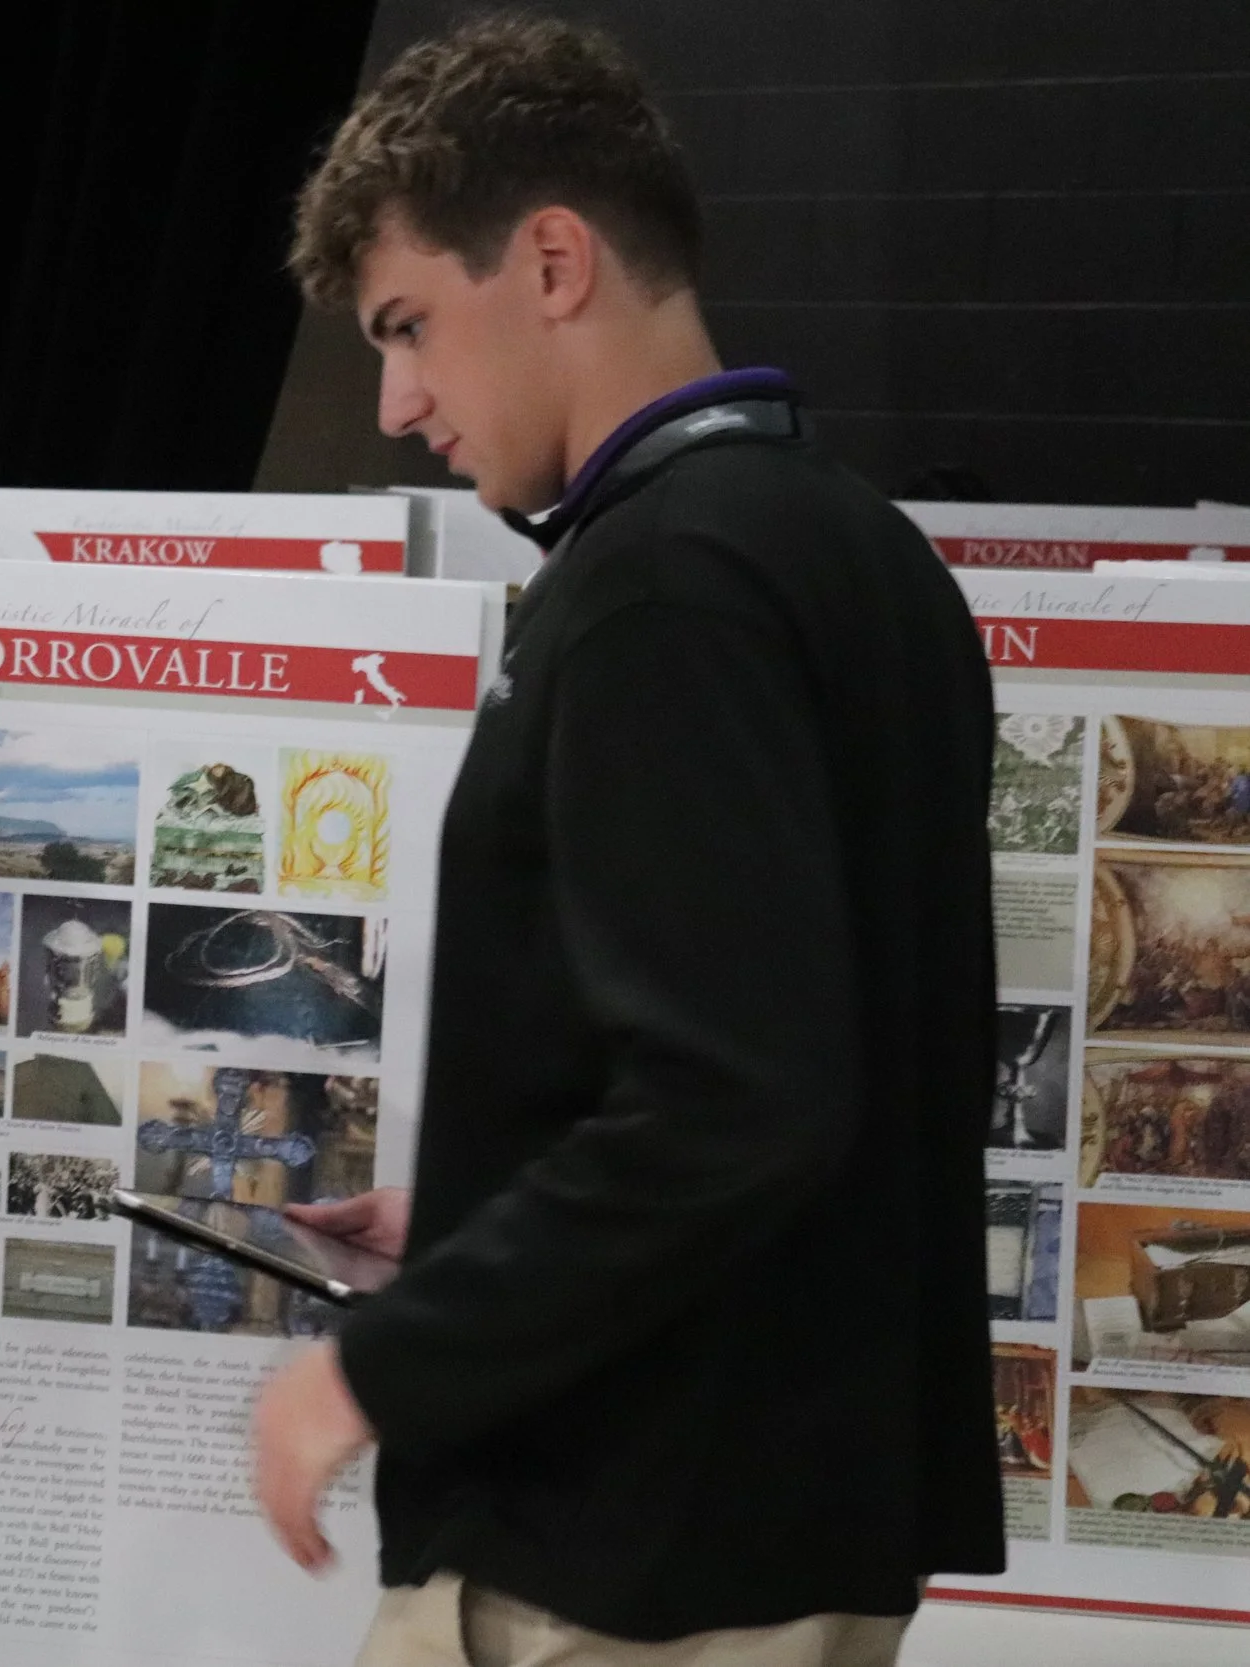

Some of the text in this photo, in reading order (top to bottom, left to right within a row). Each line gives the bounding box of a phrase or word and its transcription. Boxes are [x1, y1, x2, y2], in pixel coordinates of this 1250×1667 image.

[71, 537, 217, 565] KRAKOW
[63, 598, 168, 632] Miracle
[179, 599, 223, 640] of
[1011, 585, 1111, 615] Miracle
[1123, 583, 1170, 621] of
